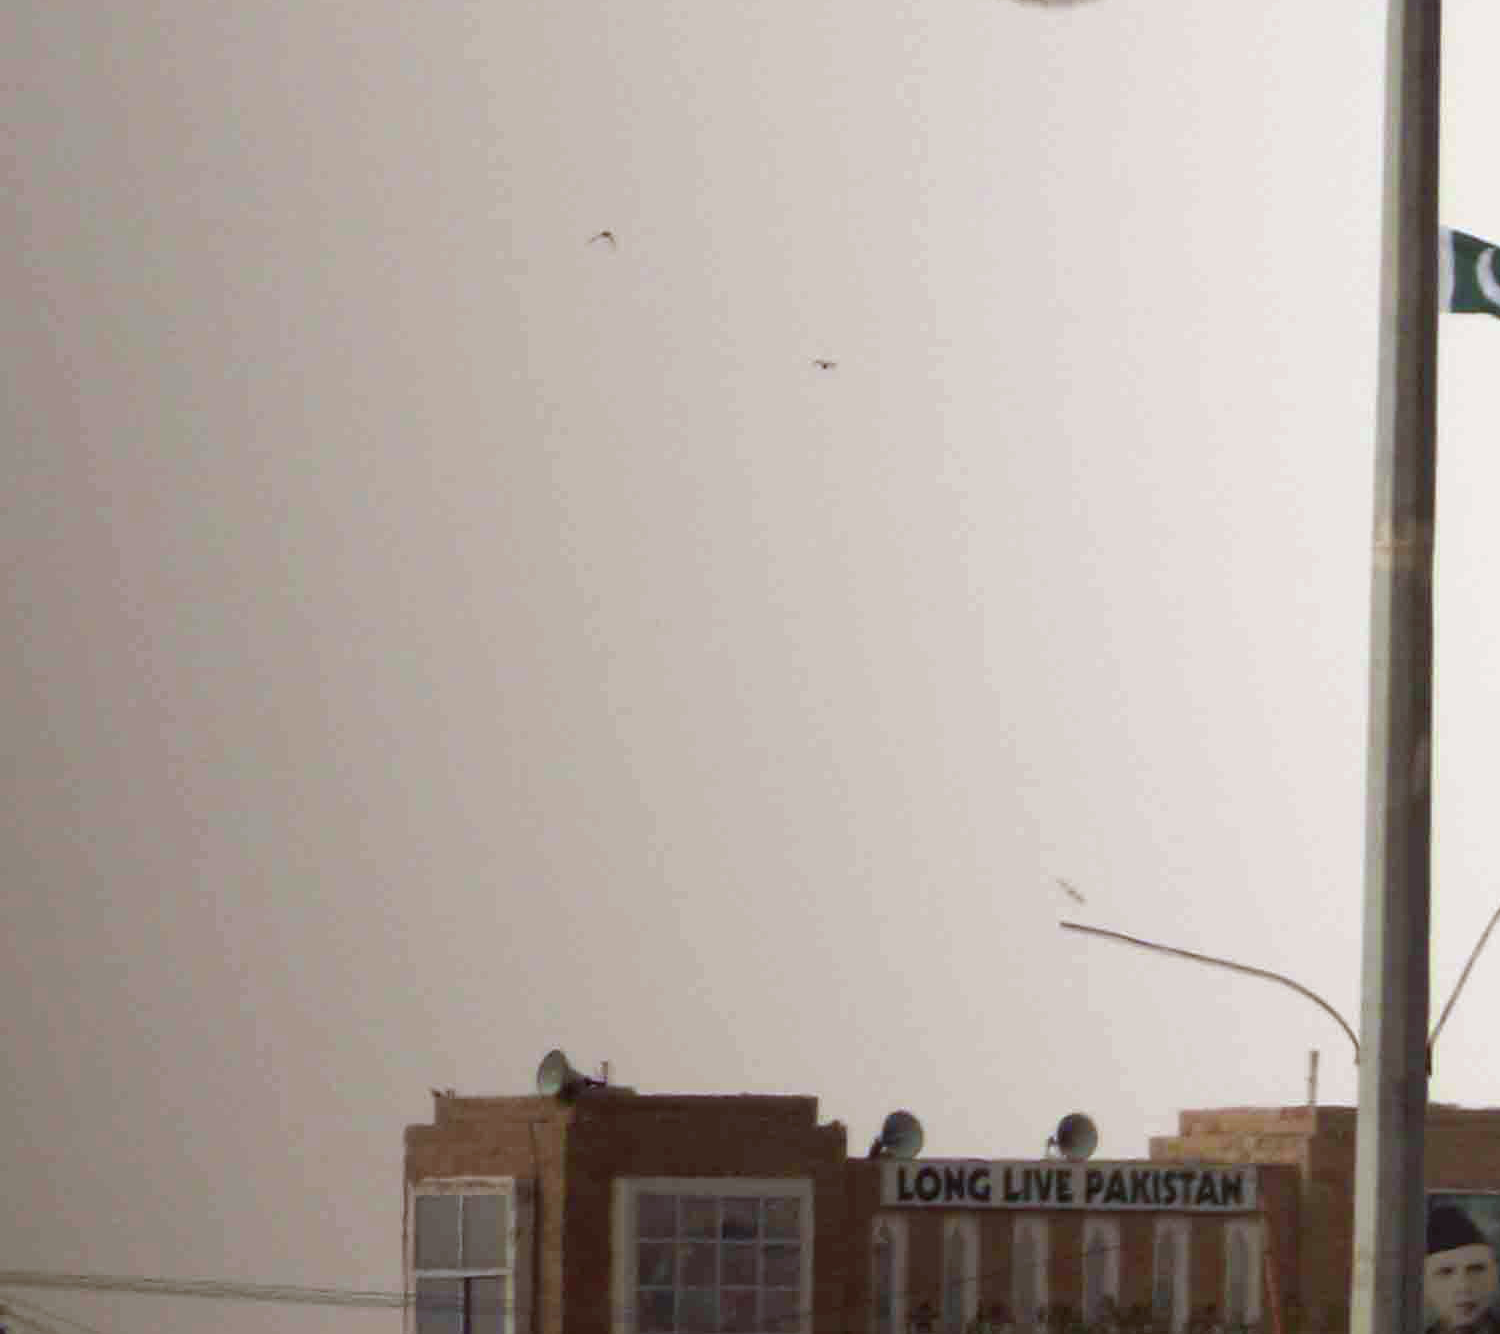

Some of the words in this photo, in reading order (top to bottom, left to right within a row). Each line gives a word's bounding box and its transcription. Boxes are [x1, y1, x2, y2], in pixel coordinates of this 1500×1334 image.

[895, 1166, 992, 1201] LONG
[1003, 1167, 1073, 1204] LIVE
[1084, 1168, 1245, 1205] PAKISTAN
